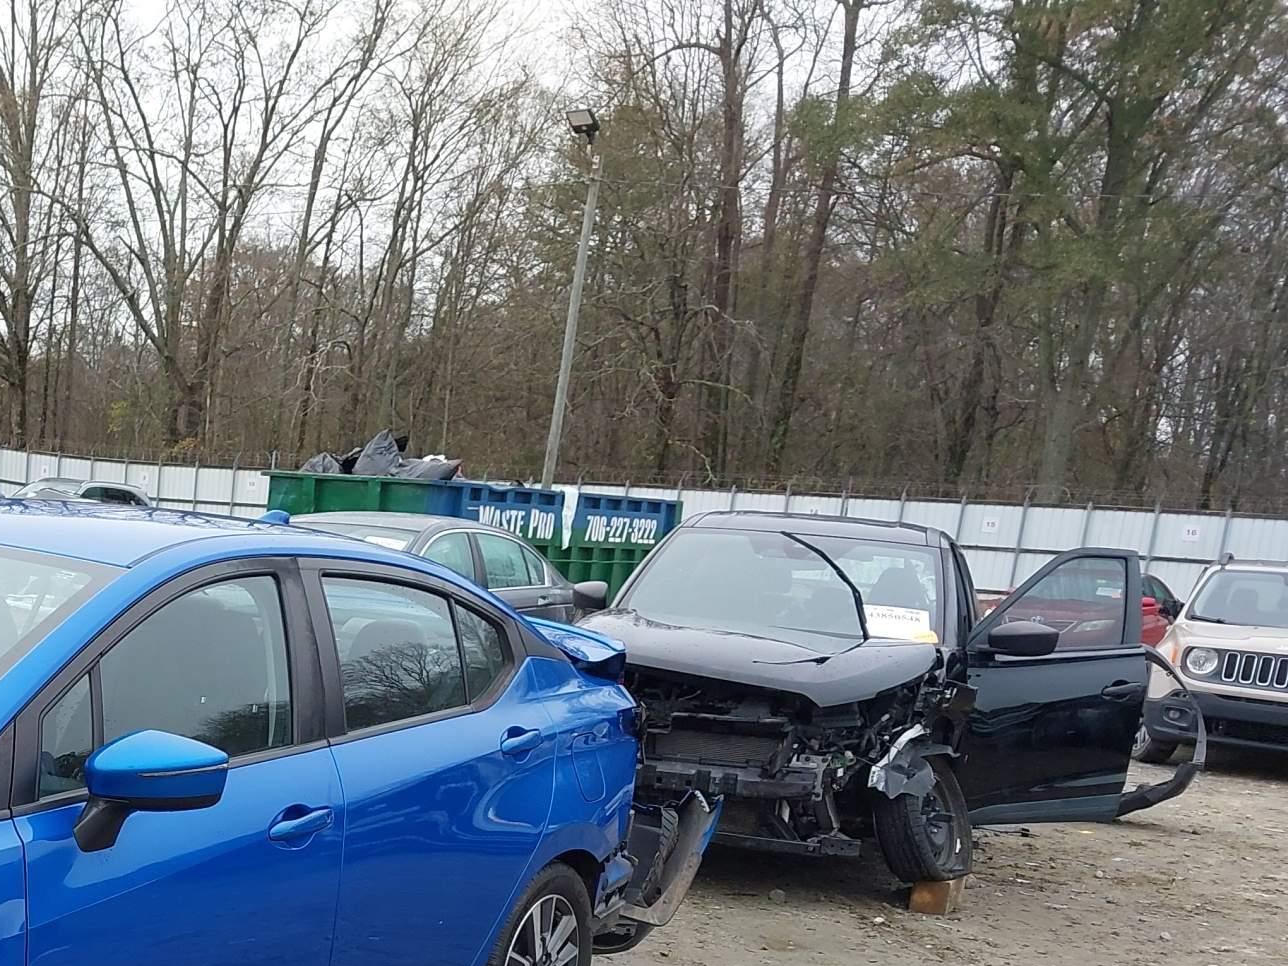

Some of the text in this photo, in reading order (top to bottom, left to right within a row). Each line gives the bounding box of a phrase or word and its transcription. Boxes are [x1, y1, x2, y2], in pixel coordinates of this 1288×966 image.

[479, 505, 555, 539] WASTE PRO
[584, 515, 658, 544] 706-227-3222
